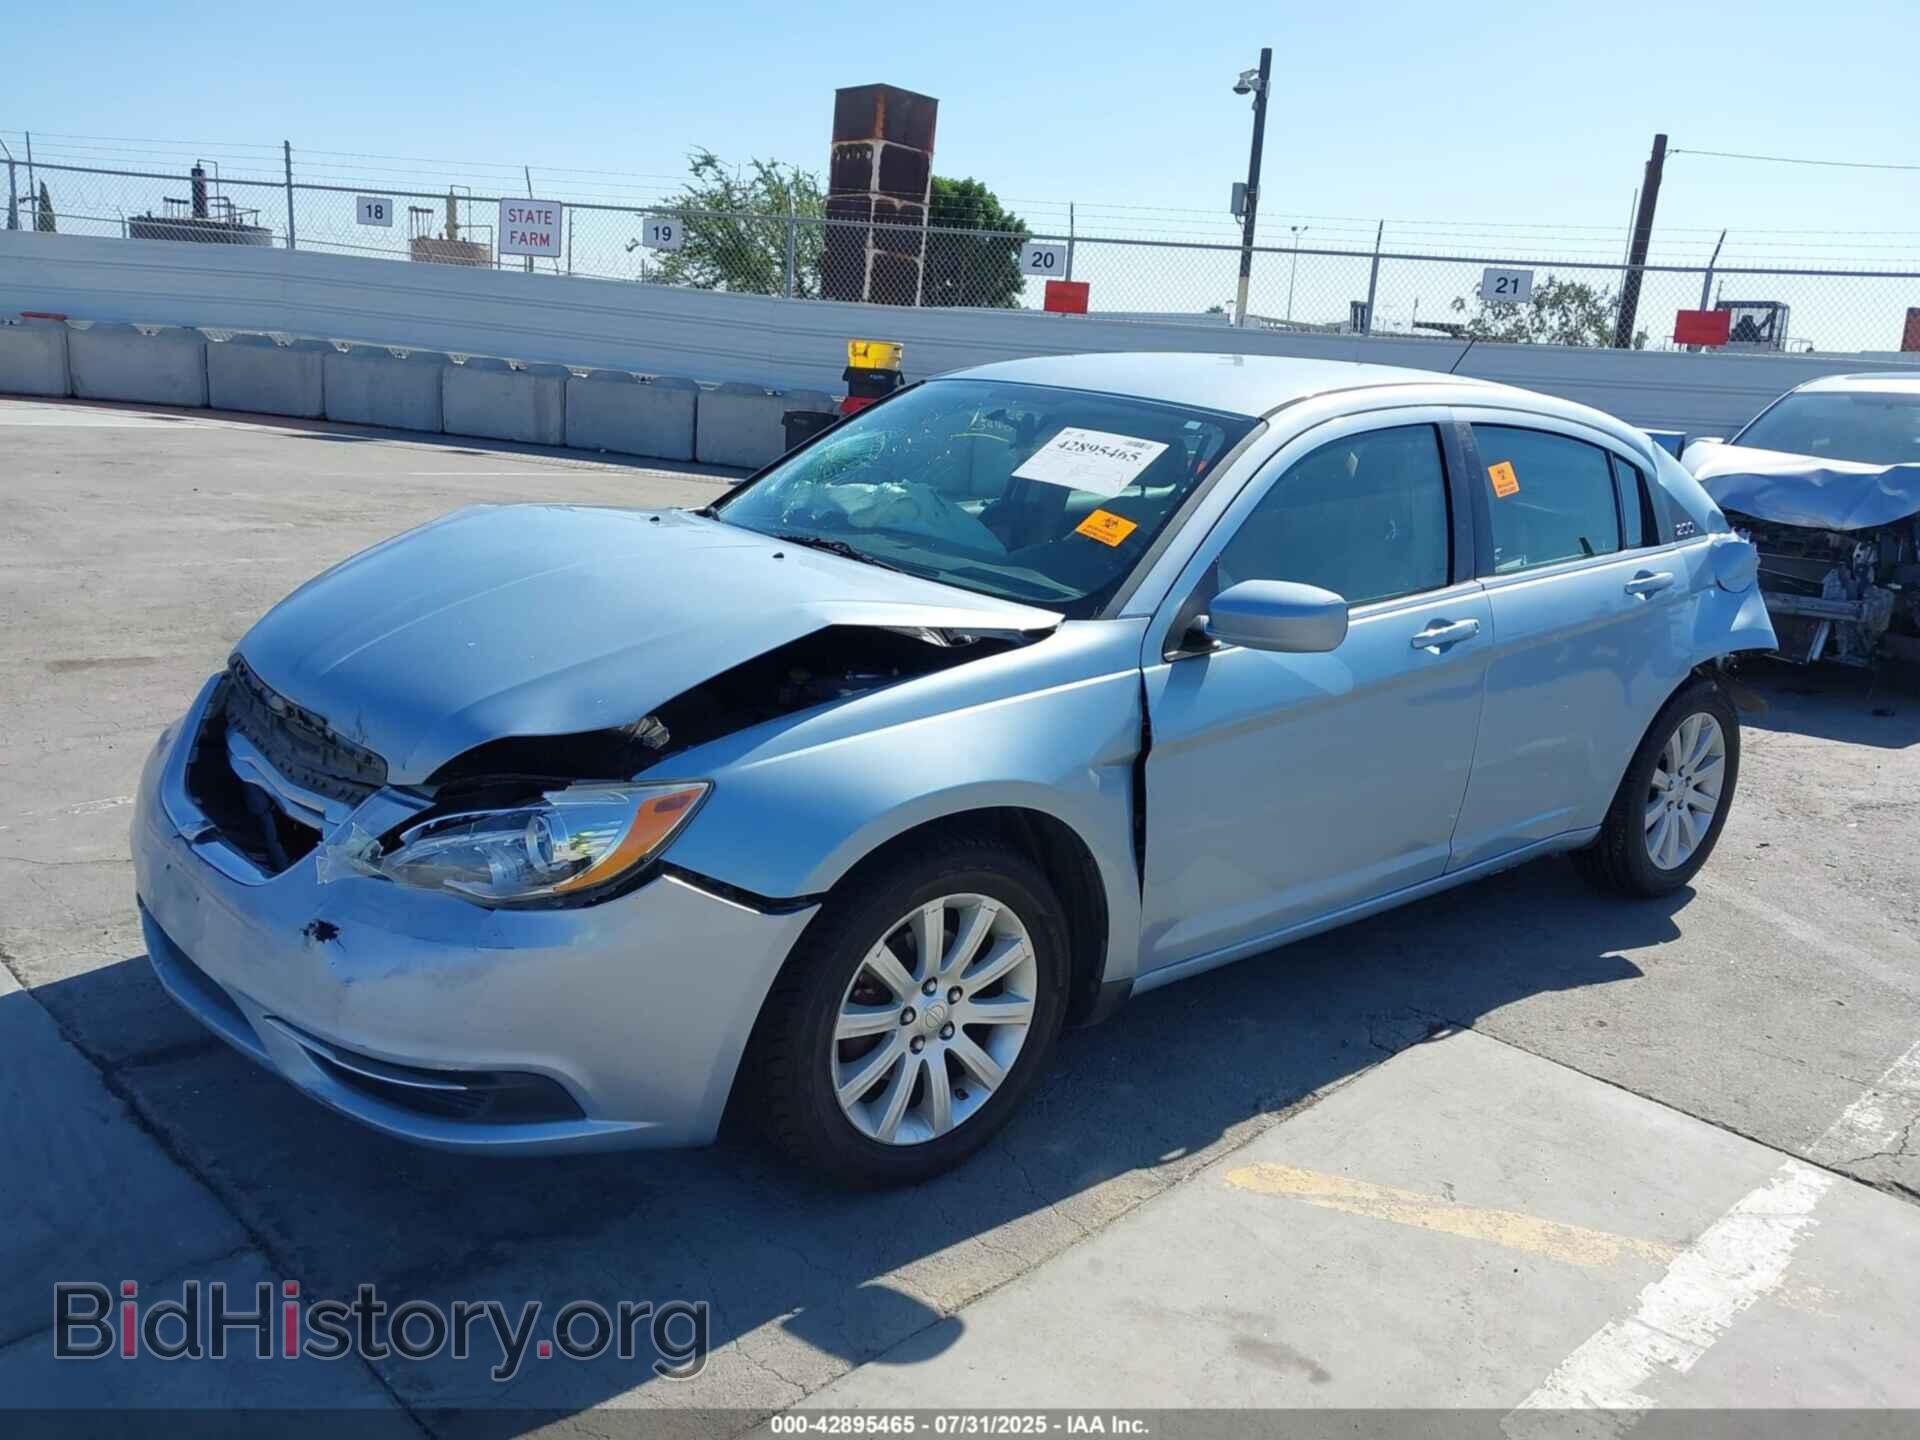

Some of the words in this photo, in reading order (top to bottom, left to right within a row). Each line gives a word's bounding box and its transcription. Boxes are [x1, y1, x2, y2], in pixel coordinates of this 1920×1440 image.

[364, 204, 384, 220] 18
[507, 208, 554, 225] STATE
[509, 230, 551, 248] FARM
[652, 226, 672, 242] 19
[1031, 251, 1055, 269] 20
[1494, 277, 1520, 295] 21
[1056, 438, 1143, 462] 42895465
[1675, 521, 1696, 536] 200
